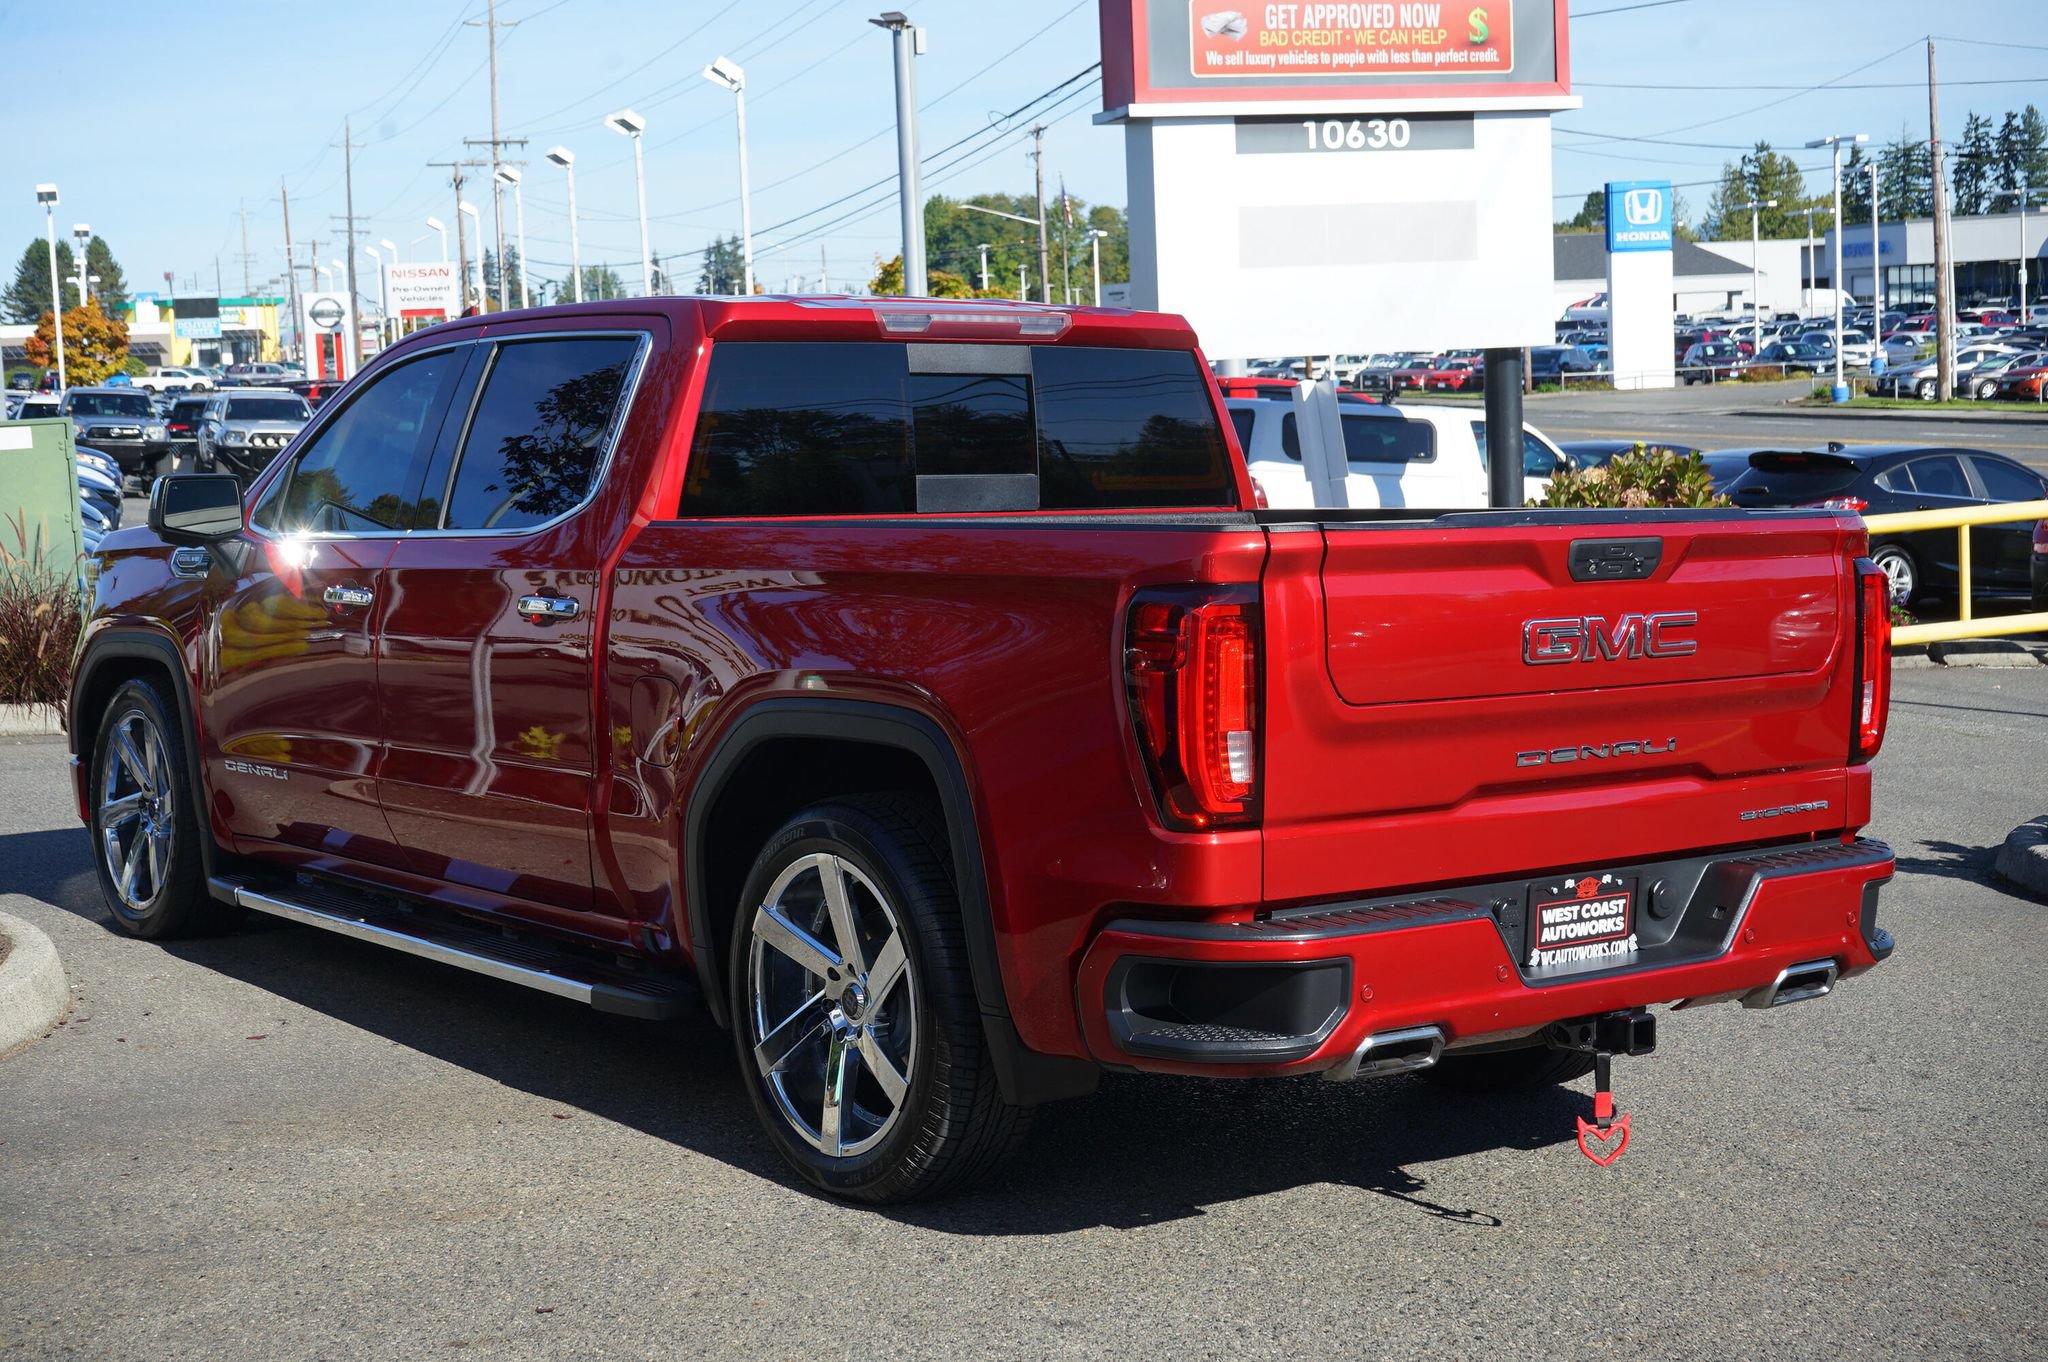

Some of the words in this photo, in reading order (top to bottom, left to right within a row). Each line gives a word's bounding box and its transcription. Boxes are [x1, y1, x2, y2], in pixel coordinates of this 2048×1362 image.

[1265, 4, 1298, 29] GET
[1303, 3, 1395, 29] APPROVED
[1400, 3, 1440, 28] NOW
[1260, 30, 1288, 46] BAD
[1291, 30, 1343, 46] CREDIT
[1354, 29, 1377, 45] WE
[1379, 29, 1408, 45] CAN
[1412, 28, 1447, 44] HELP
[1206, 51, 1222, 65] We
[1225, 50, 1243, 65] sell
[1246, 50, 1276, 68] luxury
[1278, 49, 1319, 65] vehicles
[1321, 51, 1331, 64] to
[1332, 49, 1365, 67] people
[1367, 49, 1388, 64] with
[1391, 48, 1410, 63] less
[1412, 48, 1432, 63] than
[1434, 48, 1468, 66] perfect
[1469, 48, 1499, 63] credit.
[1303, 119, 1410, 149] 10630
[1616, 231, 1669, 242] HONDA
[391, 268, 449, 278] NISSAN
[392, 285, 450, 293] Pre-Owned
[1522, 611, 1697, 666] GMC
[1516, 737, 1676, 768] DENALI
[224, 760, 289, 781] DENALI
[1740, 800, 1828, 821] SIERRA
[1542, 906, 1580, 925] WEST
[1581, 899, 1626, 919] COAST
[1541, 916, 1625, 943] AUTOWORKS
[1541, 939, 1628, 966] WCAUTOWORKS.COM
